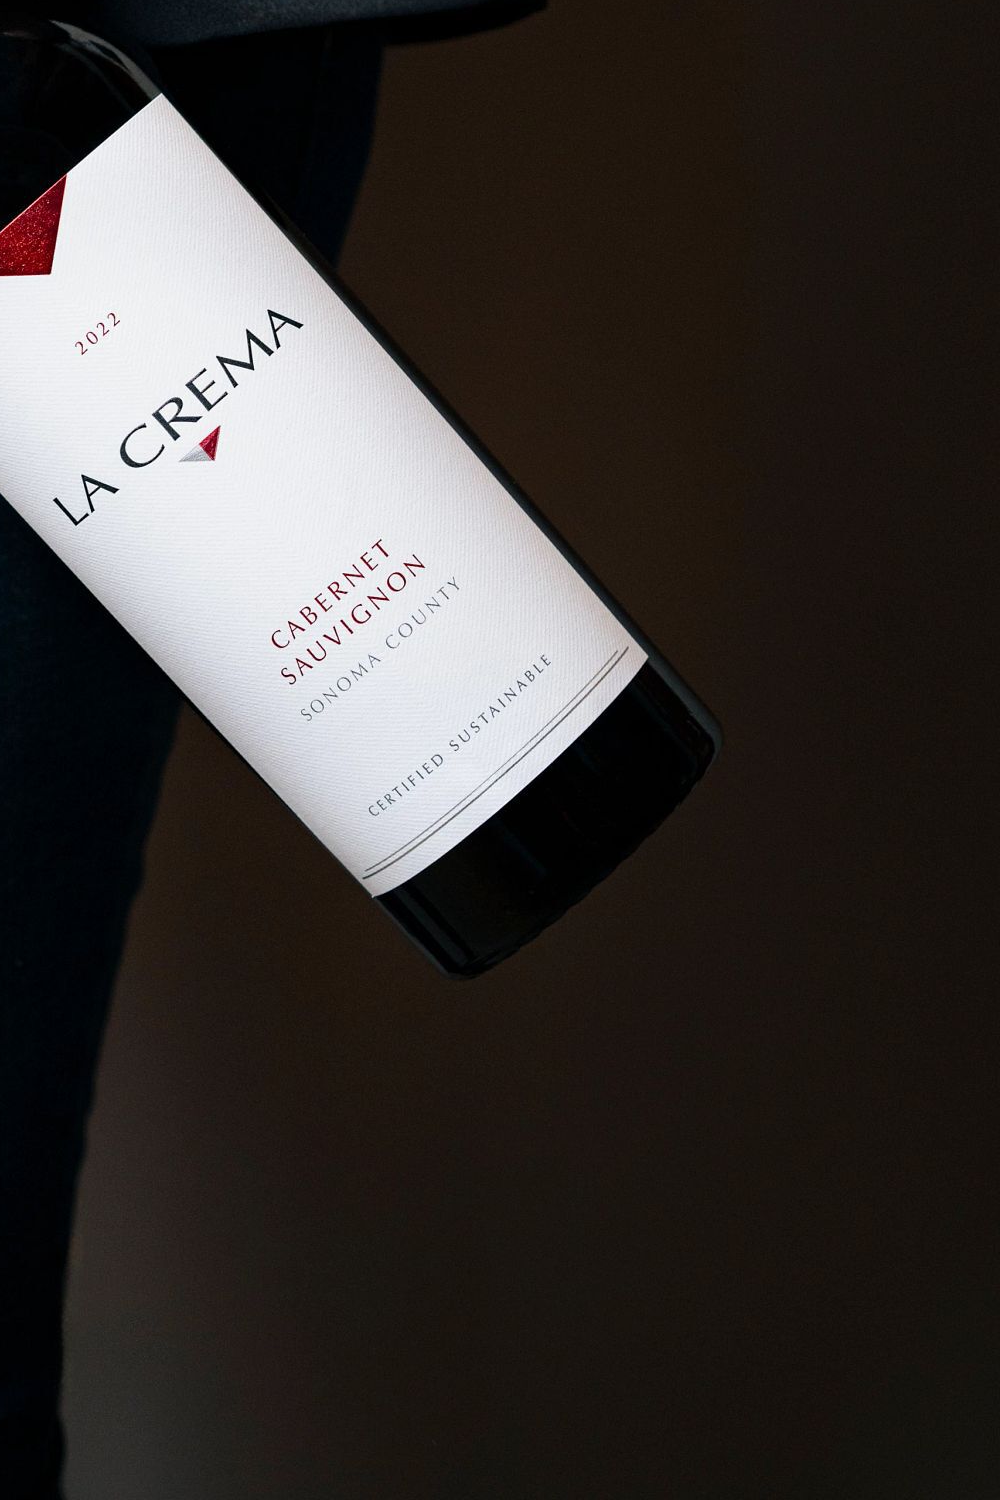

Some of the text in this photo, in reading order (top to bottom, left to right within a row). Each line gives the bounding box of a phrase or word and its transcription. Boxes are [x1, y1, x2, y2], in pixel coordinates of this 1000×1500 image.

[74, 311, 120, 355] 2022
[53, 308, 304, 526] LA CREMA
[271, 538, 390, 649] CABERNET
[280, 554, 426, 685] SAUVIGNON
[300, 576, 461, 722] SONOMA COUNTY
[368, 653, 552, 817] CERTIFIED SUSTAINABLE
